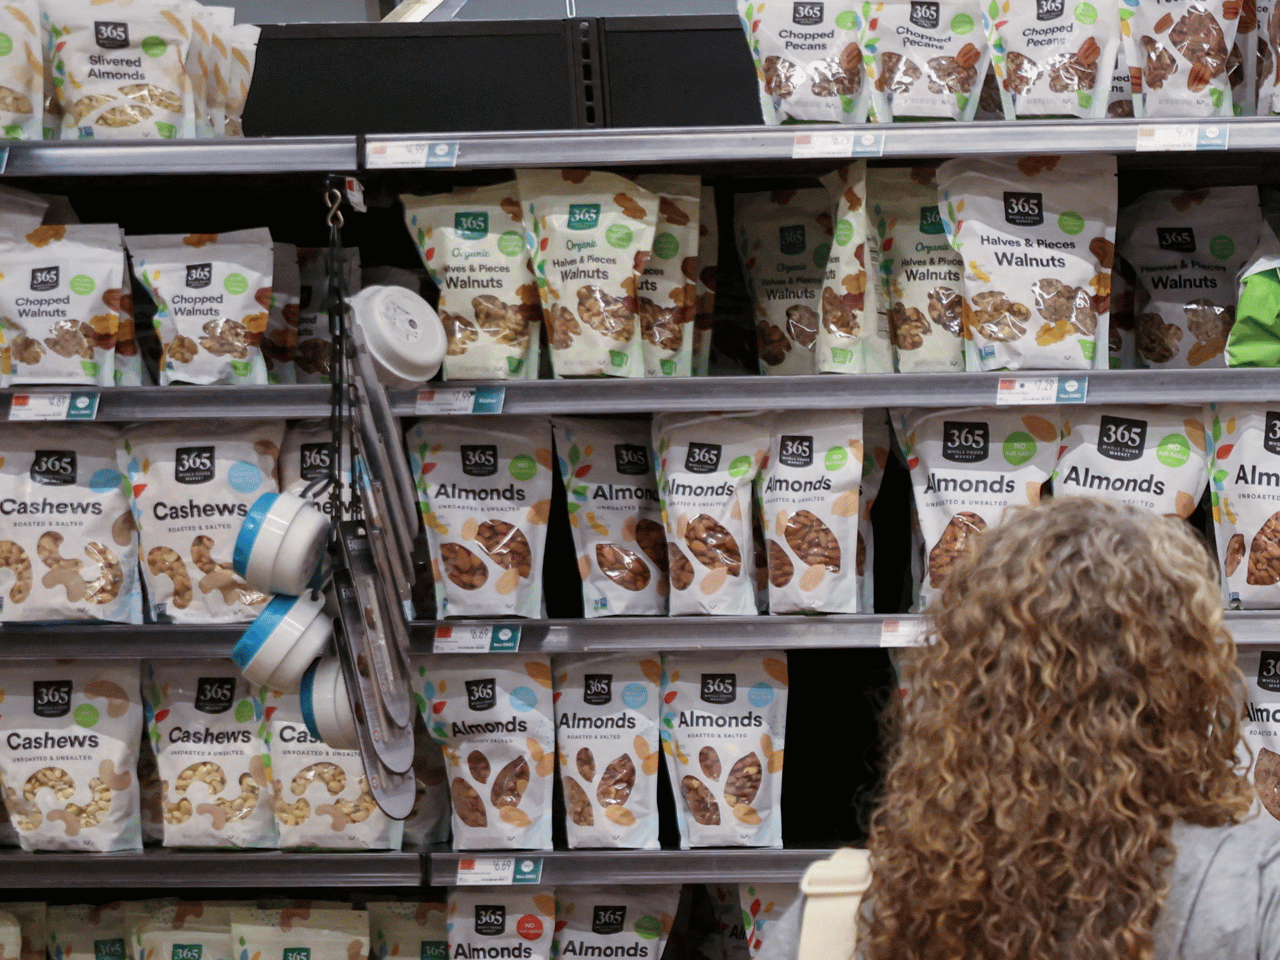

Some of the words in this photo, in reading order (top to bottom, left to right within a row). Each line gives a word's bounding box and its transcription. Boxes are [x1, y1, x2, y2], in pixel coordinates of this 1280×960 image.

[779, 30, 834, 41] Chopped
[786, 41, 826, 50] Pecans
[89, 54, 141, 67] Slivered
[88, 68, 144, 80] Almonds
[1008, 194, 1041, 214] 365
[566, 239, 598, 250] Organic
[981, 236, 1021, 246] Halves
[1024, 238, 1033, 247] &
[1037, 239, 1075, 248] Pieces
[995, 252, 1065, 267] Walnuts
[560, 268, 608, 282] Walnuts
[16, 296, 69, 306] Chopped
[18, 308, 66, 318] Walnuts
[435, 484, 525, 500] Almonds
[154, 500, 248, 520] Cashews
[454, 943, 532, 959] Almonds
